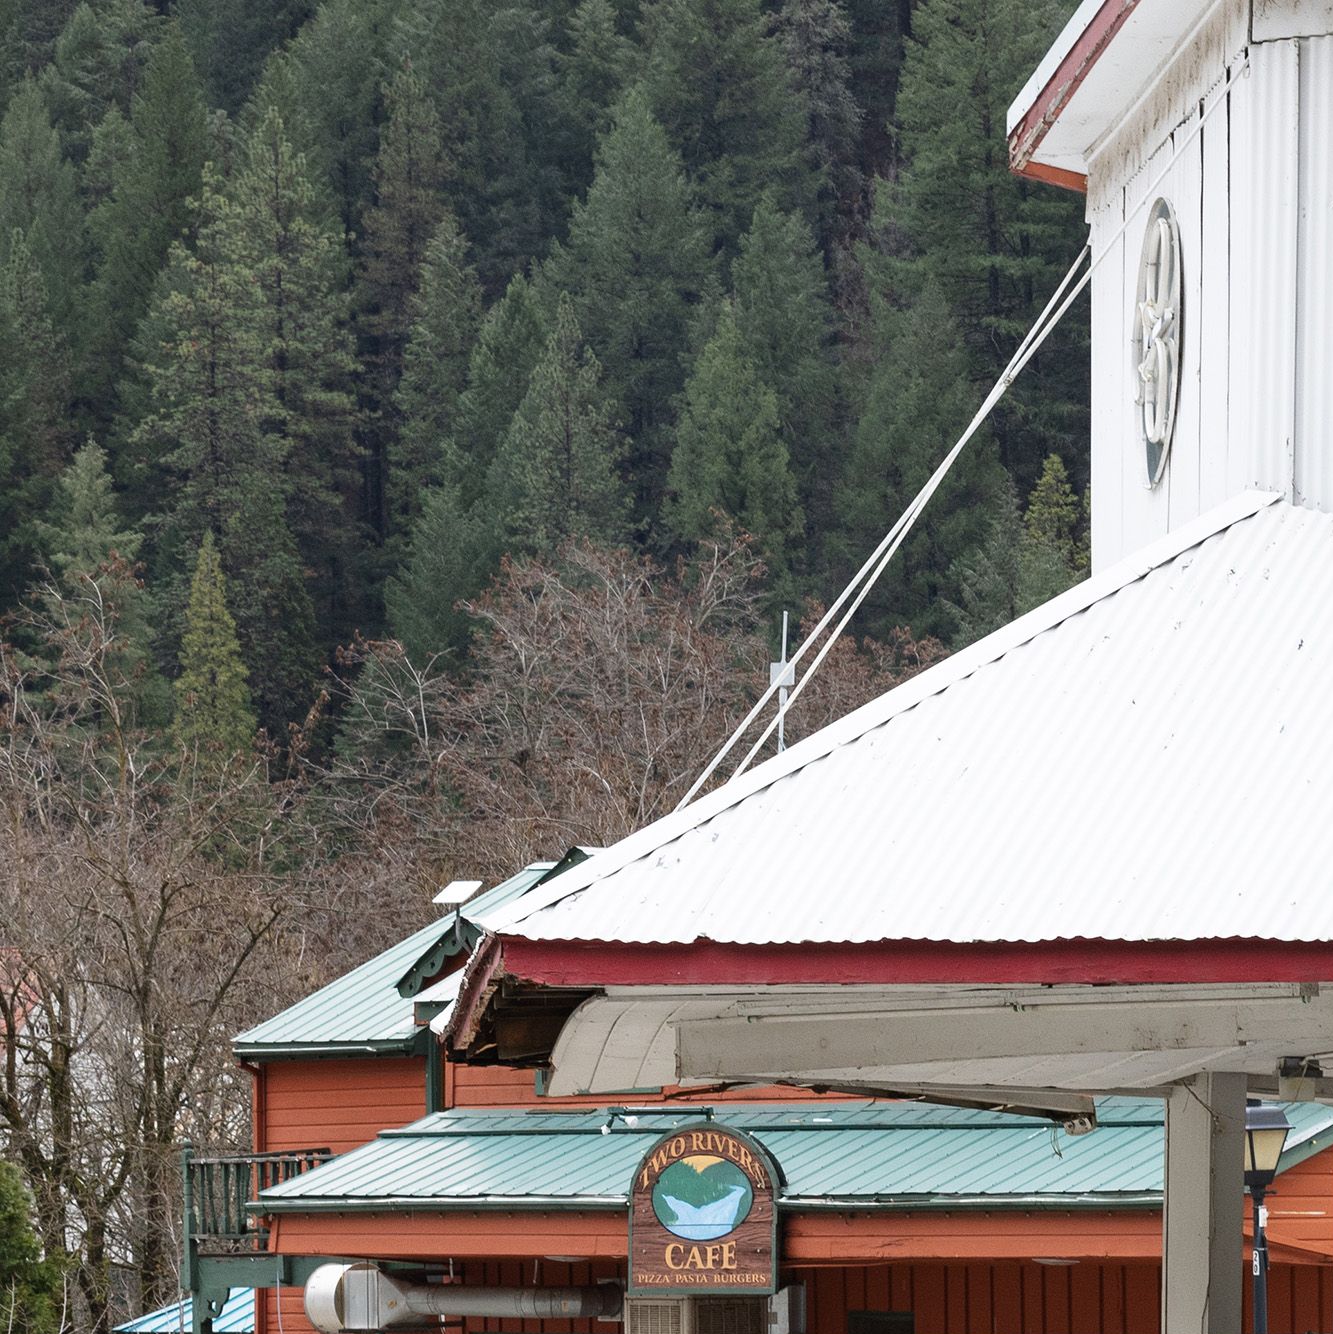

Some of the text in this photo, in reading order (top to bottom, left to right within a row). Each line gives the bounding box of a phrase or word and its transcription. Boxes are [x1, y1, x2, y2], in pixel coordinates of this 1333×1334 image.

[639, 1132, 766, 1192] TWO RIVERS
[665, 1241, 738, 1270] CAFE
[638, 1273, 766, 1284] PIZZA PASTA BURGERS
